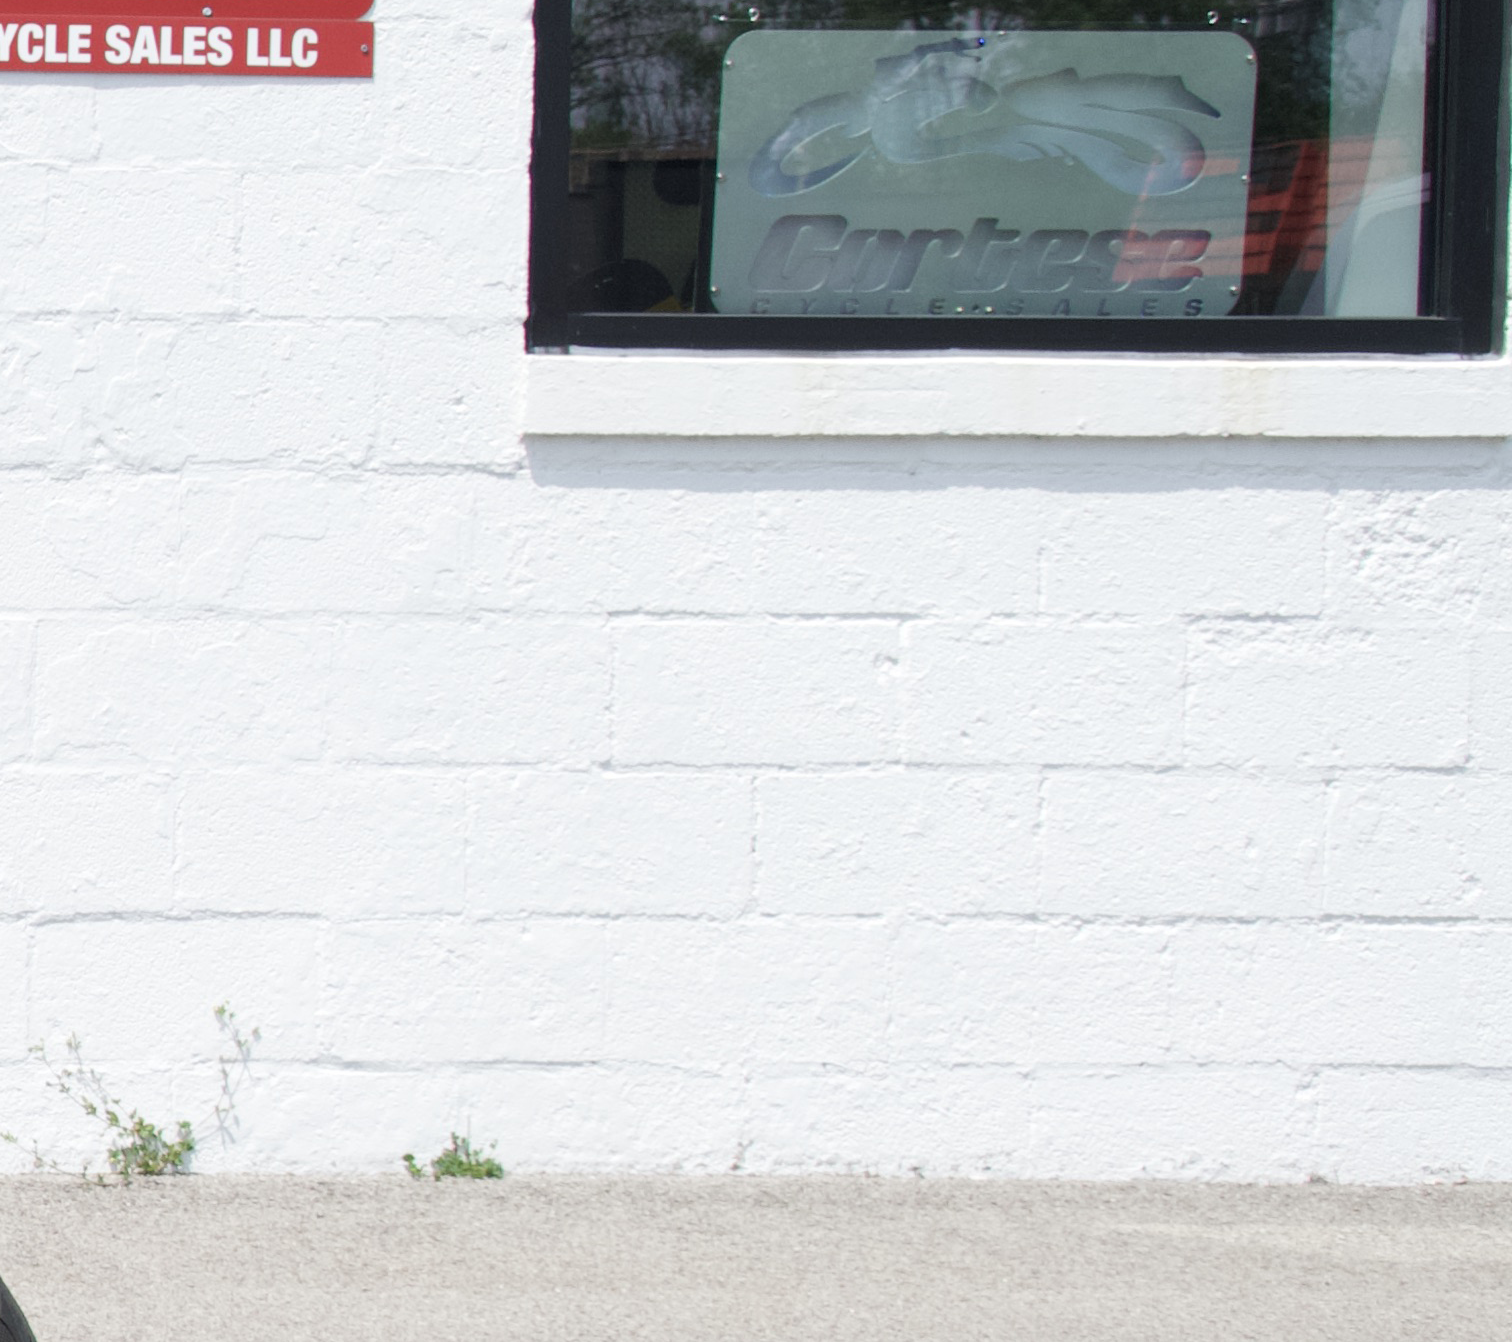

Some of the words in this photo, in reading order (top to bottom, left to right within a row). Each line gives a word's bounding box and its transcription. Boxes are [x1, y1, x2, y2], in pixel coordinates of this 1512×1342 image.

[105, 26, 233, 65] SALES
[246, 29, 318, 68] LLC
[749, 214, 1211, 293] Cortese
[750, 298, 946, 316] CYCLE
[1005, 298, 1204, 316] SALES
